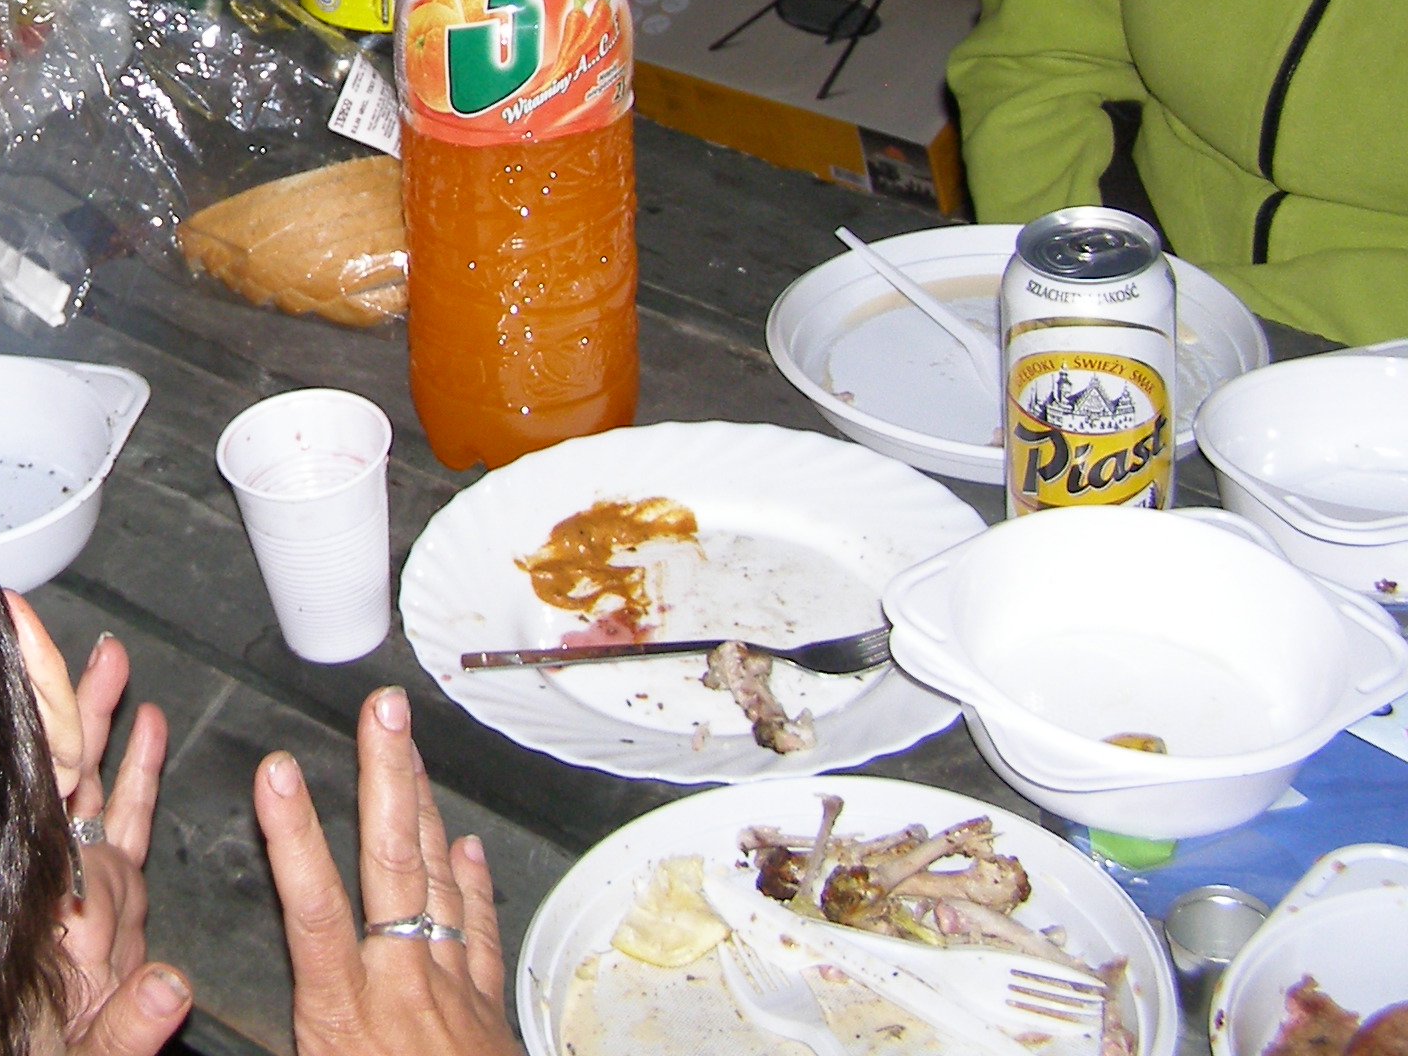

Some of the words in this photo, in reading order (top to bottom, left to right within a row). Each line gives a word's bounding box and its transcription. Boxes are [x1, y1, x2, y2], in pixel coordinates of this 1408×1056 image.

[501, 72, 572, 125] Witaminy
[1073, 355, 1126, 375] ŚWIEŻY
[1014, 416, 1167, 495] Piast
